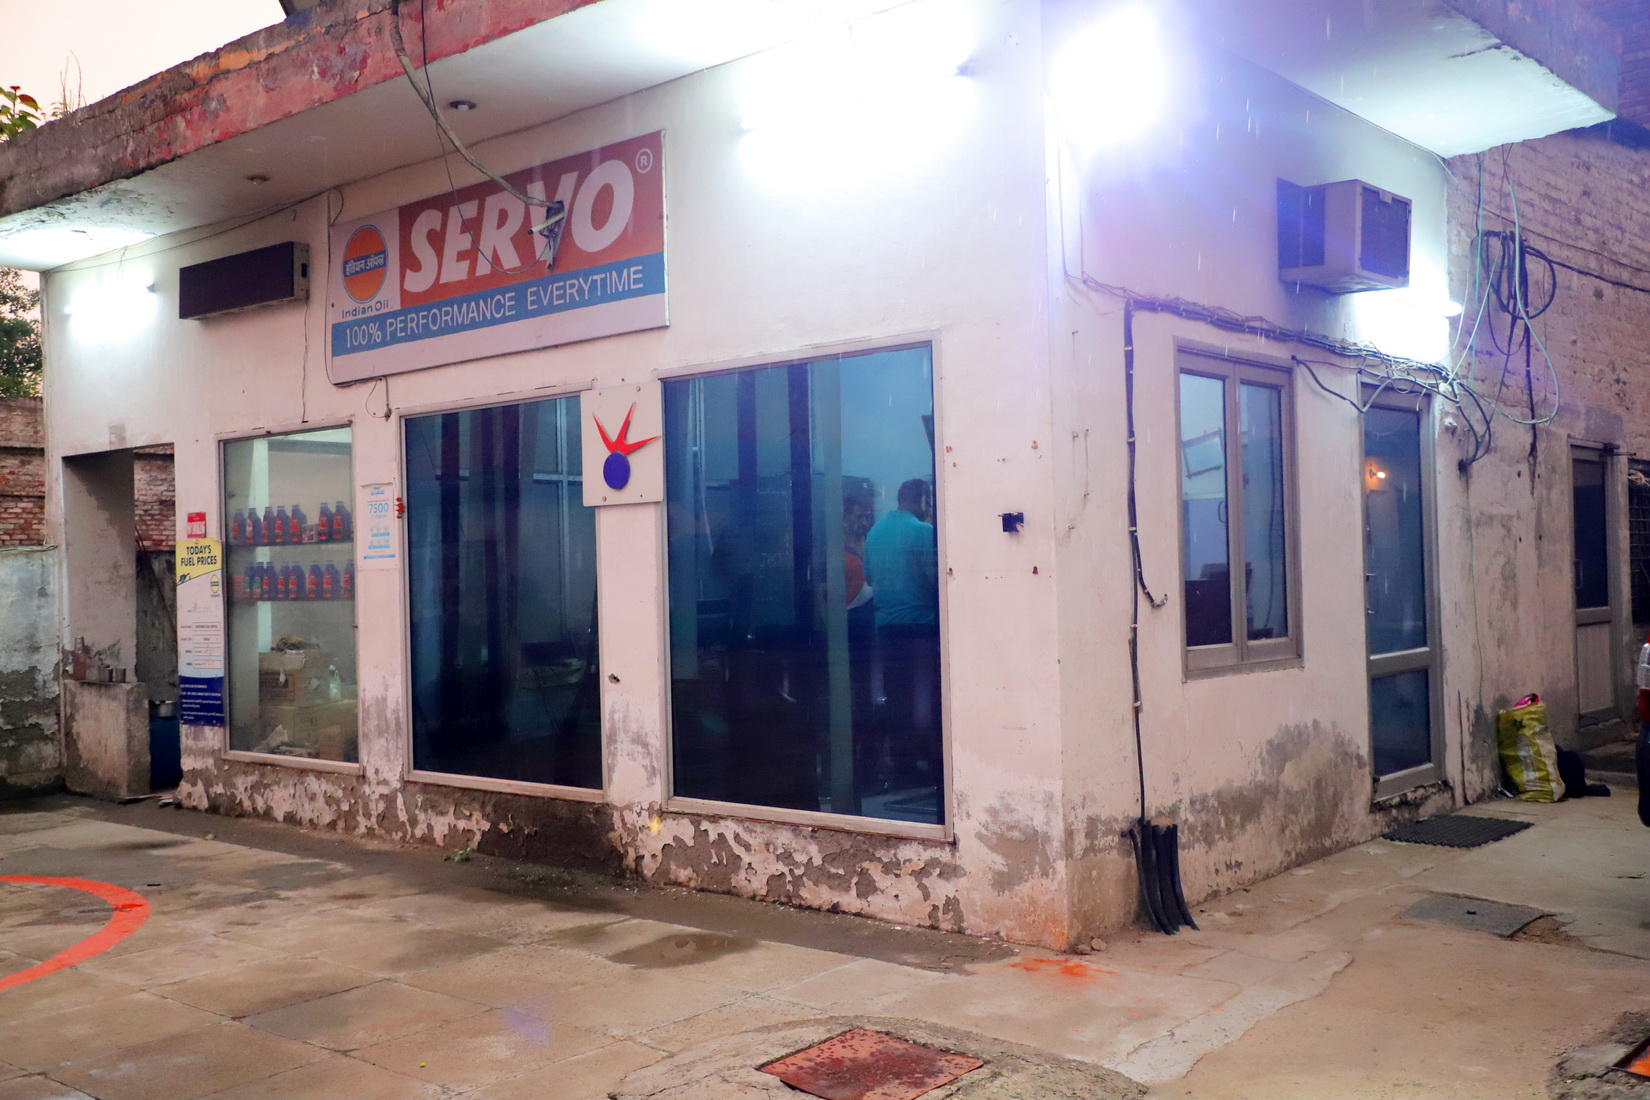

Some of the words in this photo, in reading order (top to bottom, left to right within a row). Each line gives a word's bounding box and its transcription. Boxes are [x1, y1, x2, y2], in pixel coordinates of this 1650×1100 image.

[403, 159, 635, 293] SERVO
[345, 257, 365, 276] इंडियन
[365, 253, 385, 271] ऑयल
[346, 321, 382, 349] 100%
[386, 292, 516, 341] PERFORMANCE
[527, 265, 644, 311] EVERYTIME
[368, 502, 389, 514] 7500
[186, 545, 212, 556] TODAY'S
[180, 557, 195, 567] FUEL
[196, 555, 217, 566] PRICES
